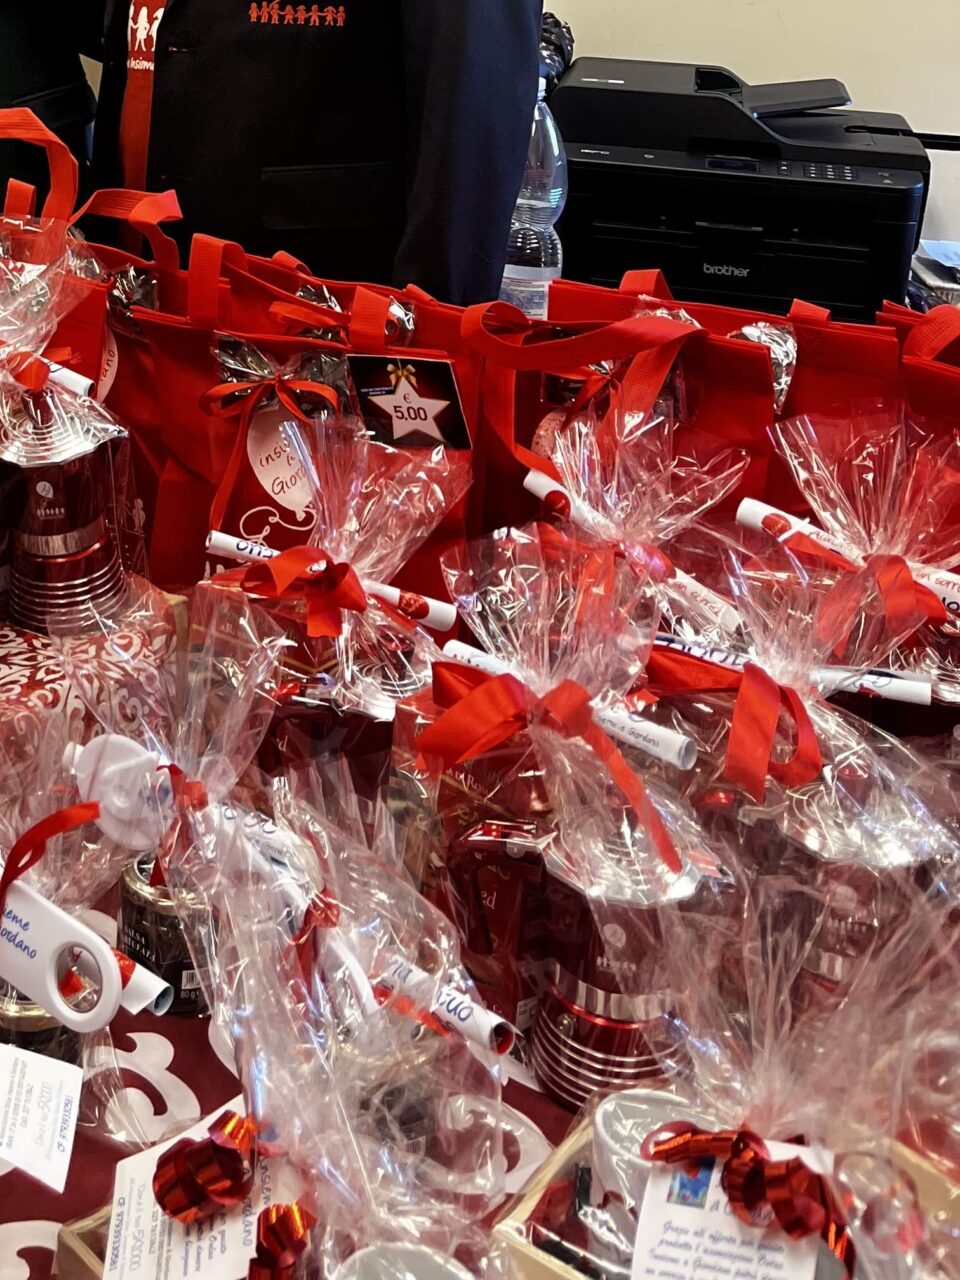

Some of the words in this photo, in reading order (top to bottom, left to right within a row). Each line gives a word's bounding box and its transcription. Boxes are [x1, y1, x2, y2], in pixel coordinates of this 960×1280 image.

[702, 262, 751, 278] brother
[403, 393, 412, 403] €
[57, 1142, 66, 1152] CF
